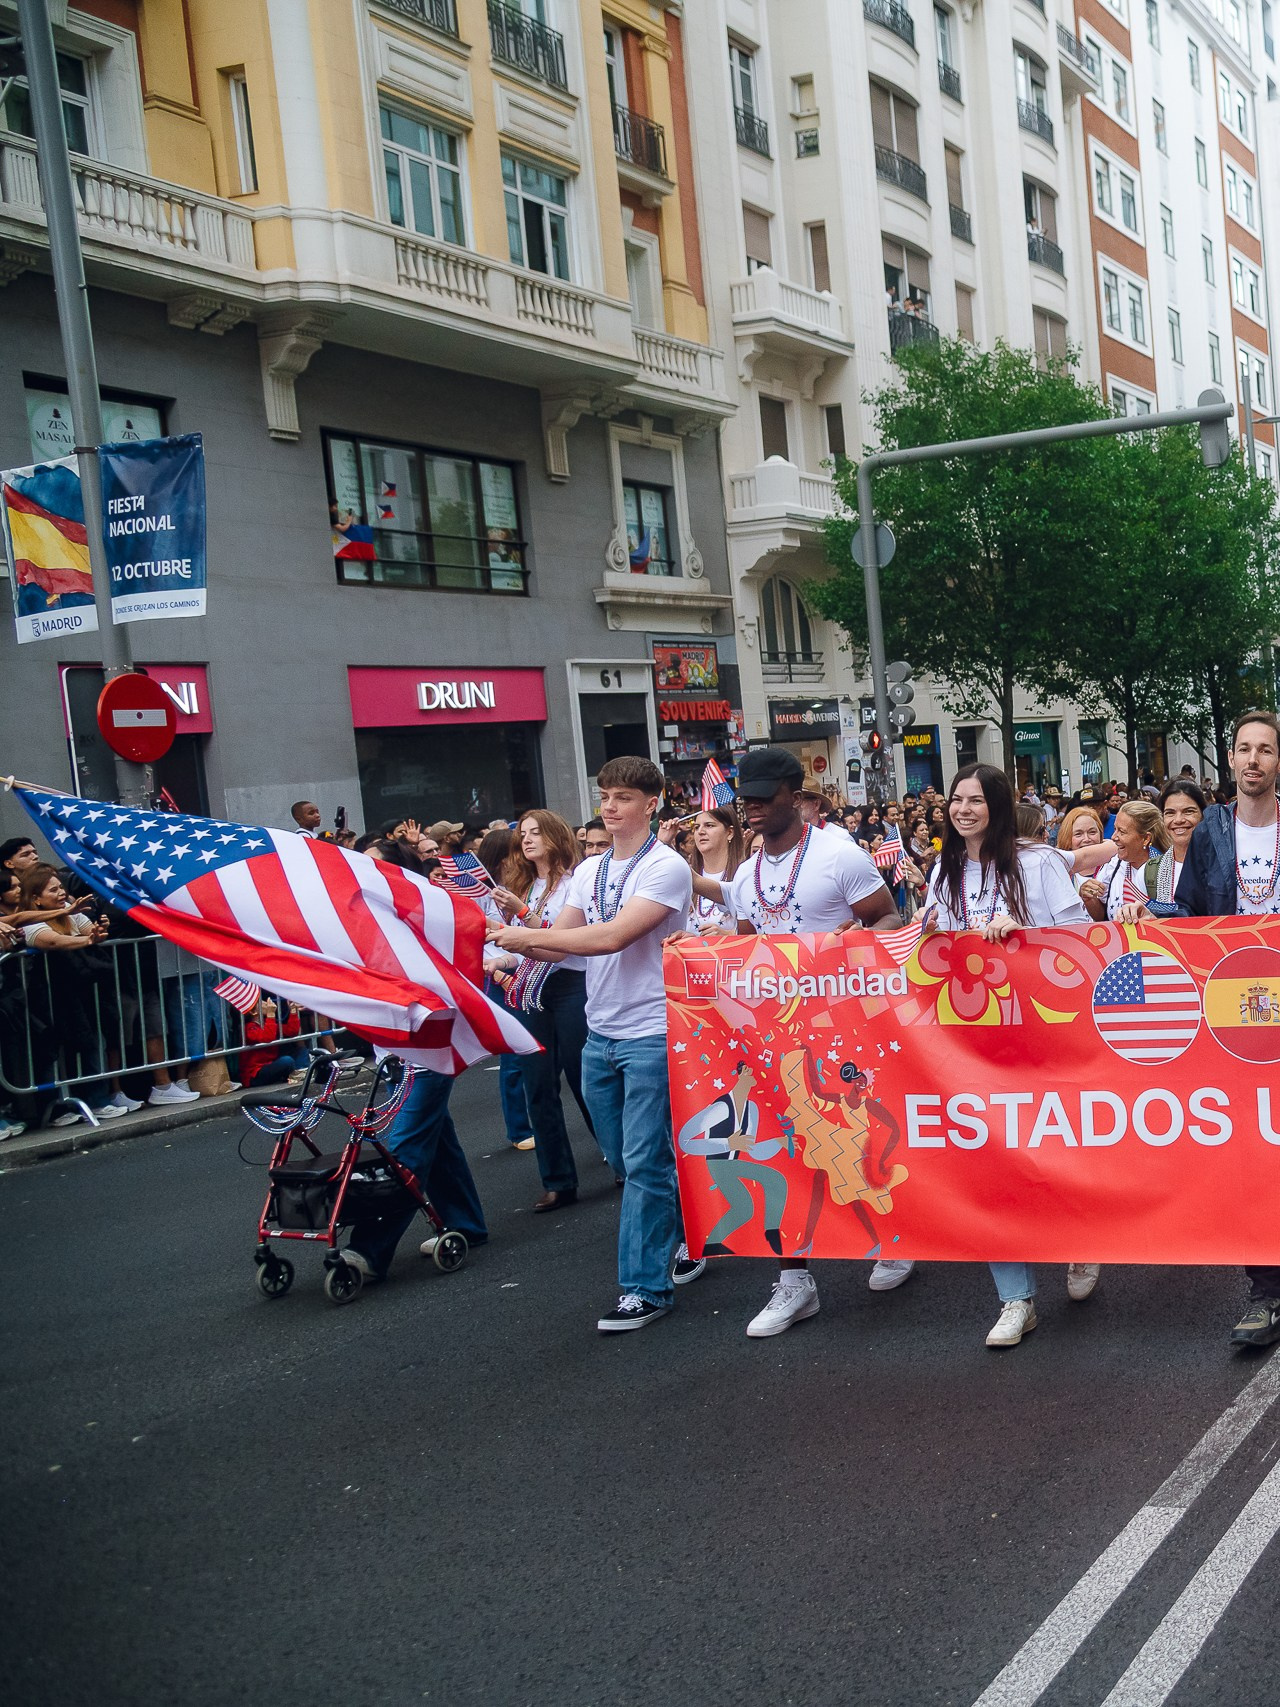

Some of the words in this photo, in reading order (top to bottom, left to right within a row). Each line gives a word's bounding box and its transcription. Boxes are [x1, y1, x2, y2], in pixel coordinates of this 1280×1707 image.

[47, 419, 69, 431] ZEN
[121, 430, 140, 440] ZEN
[108, 495, 145, 515] FIESTA
[109, 515, 176, 537] NACIONAL
[112, 565, 122, 582] 12
[124, 559, 191, 579] OCTUBRE
[133, 603, 155, 612] CRUZAN
[169, 600, 200, 609] CAMINOS
[42, 615, 82, 632] MADRID
[600, 670, 622, 688] 61
[418, 681, 496, 710] DRUNI
[660, 700, 732, 721] SOUVENIRS
[1014, 730, 1040, 741] Ginos
[761, 908, 791, 928] 250
[729, 965, 908, 1002] Hispanidad
[904, 1086, 1234, 1150] ESTADOS
